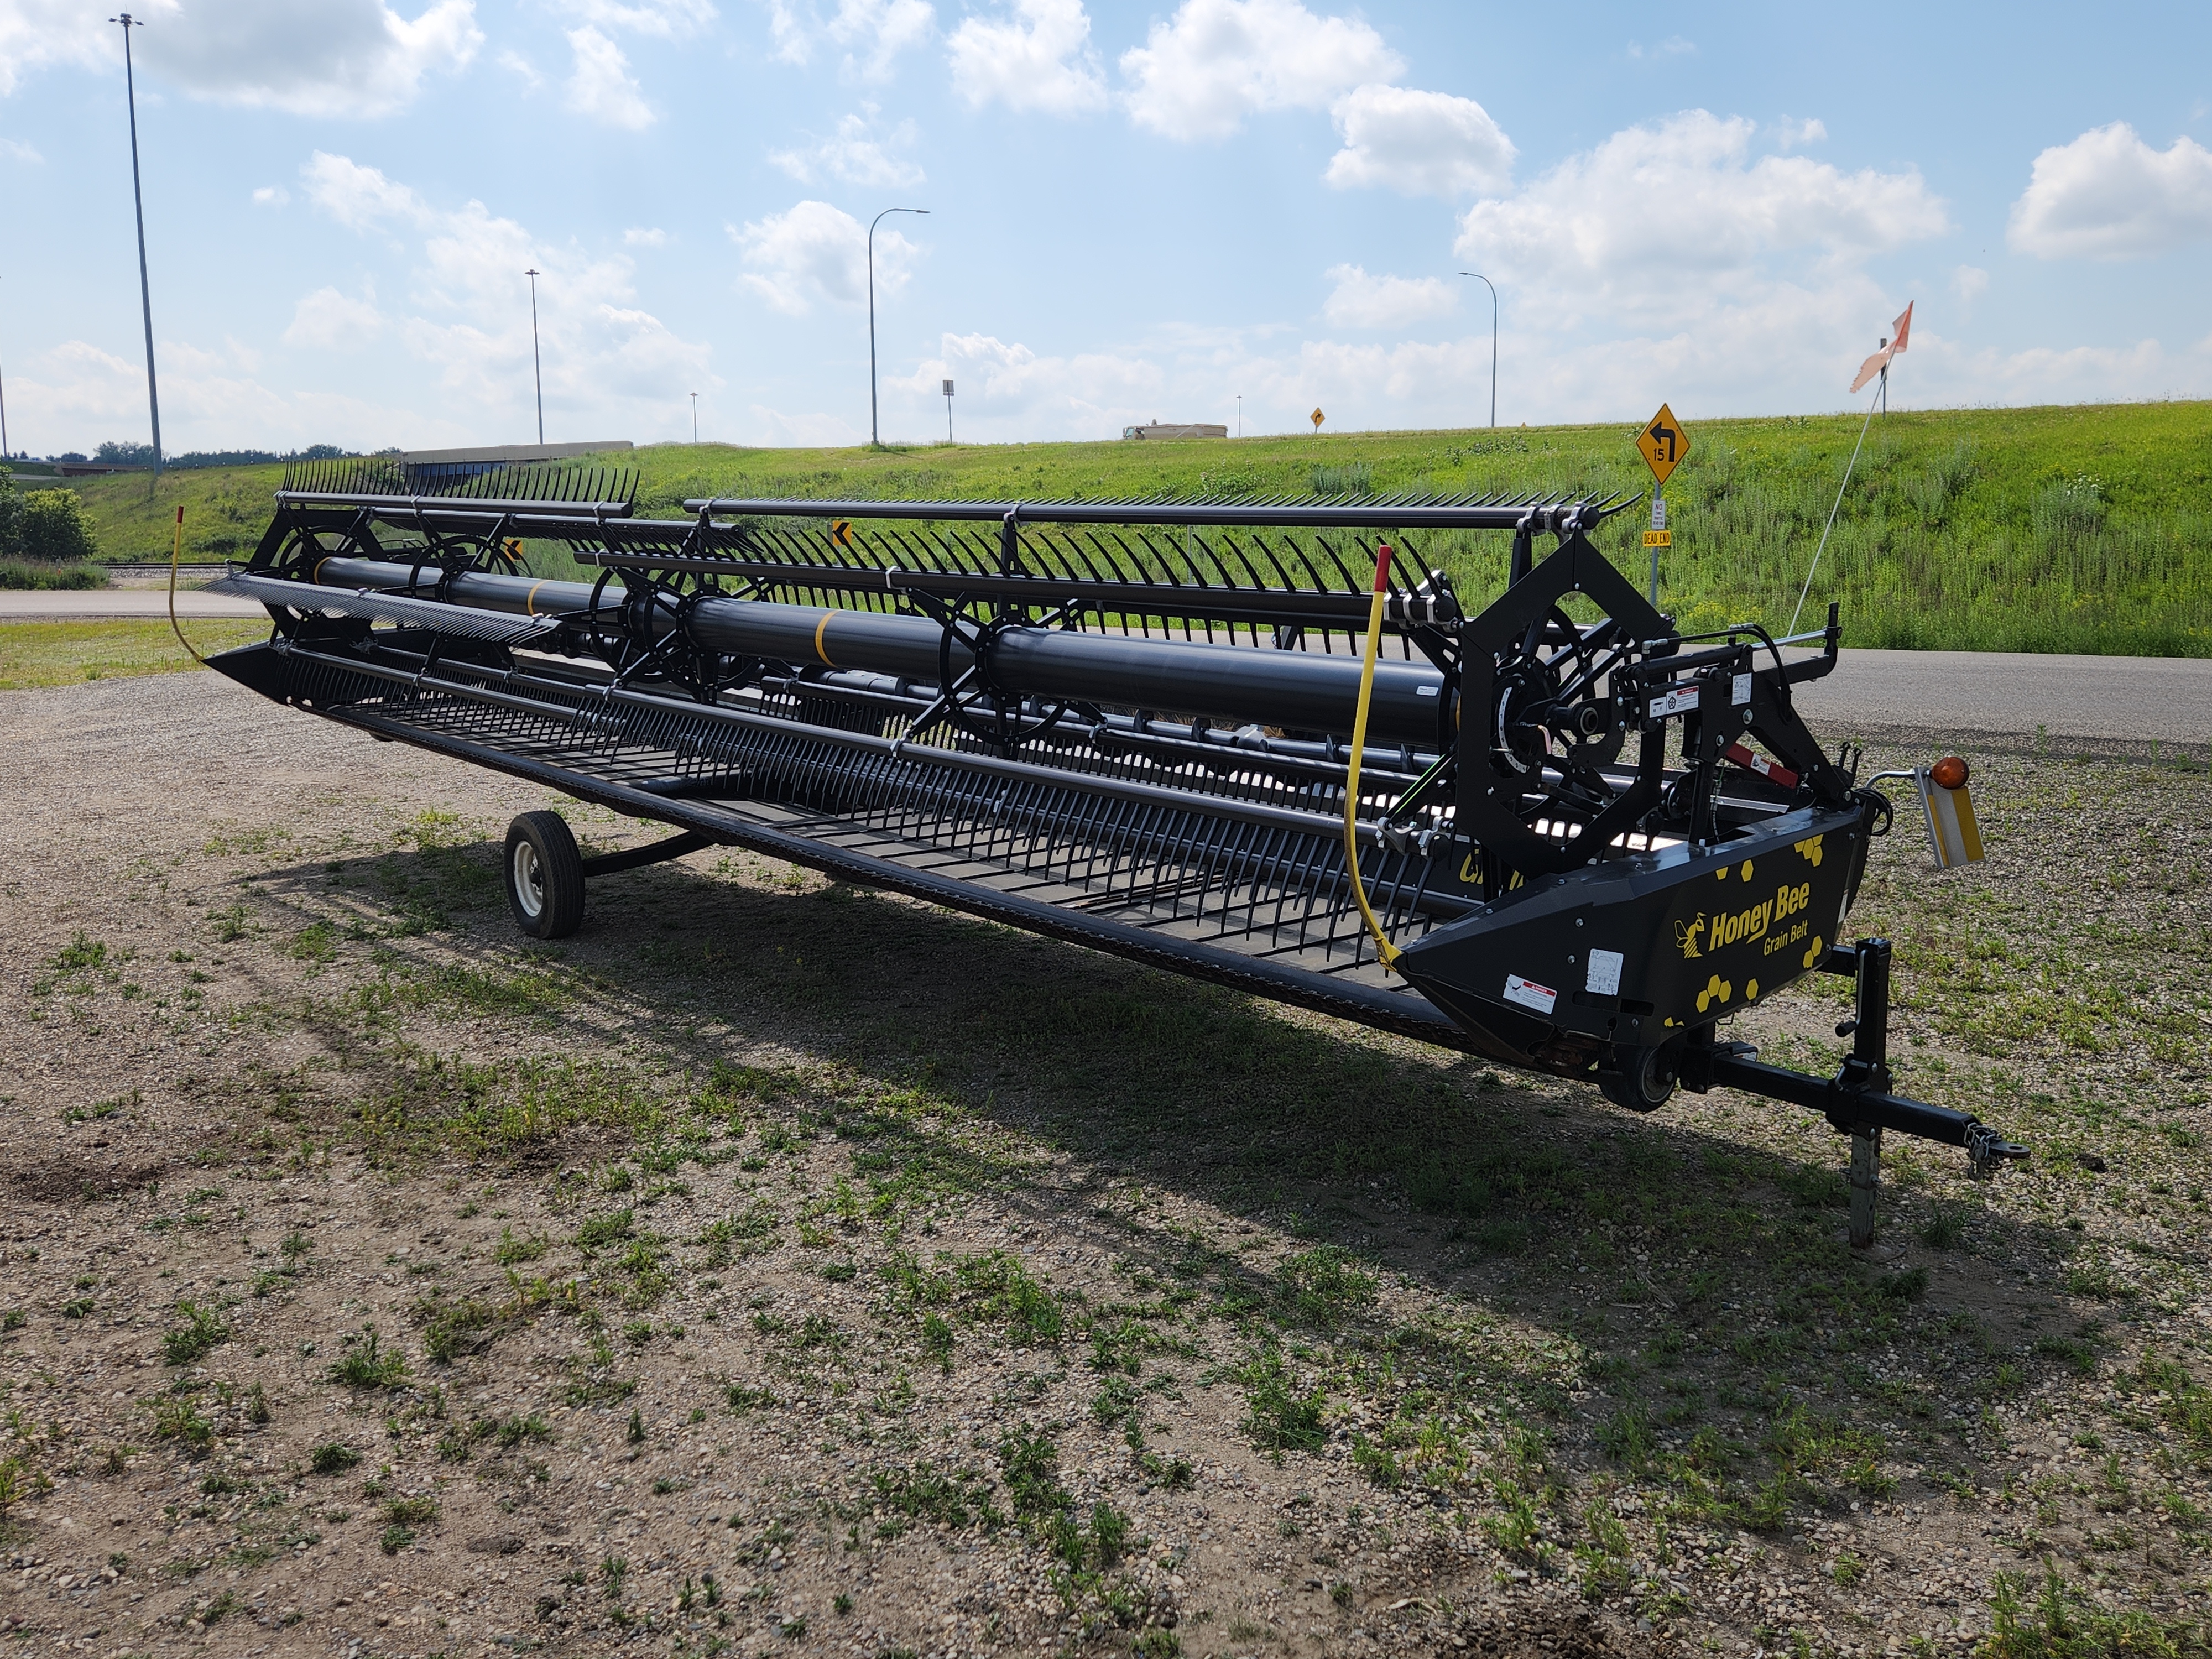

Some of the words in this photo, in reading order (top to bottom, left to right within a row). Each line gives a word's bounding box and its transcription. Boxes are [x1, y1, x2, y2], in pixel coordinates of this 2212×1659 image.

[1653, 448, 1665, 462] 15
[1644, 533, 1657, 544] DEAD
[1660, 533, 1670, 543] END
[1708, 898, 1773, 952] Honey
[1773, 882, 1809, 922] Bee
[1764, 931, 1788, 956] Grain
[1790, 919, 1808, 943] Belt
